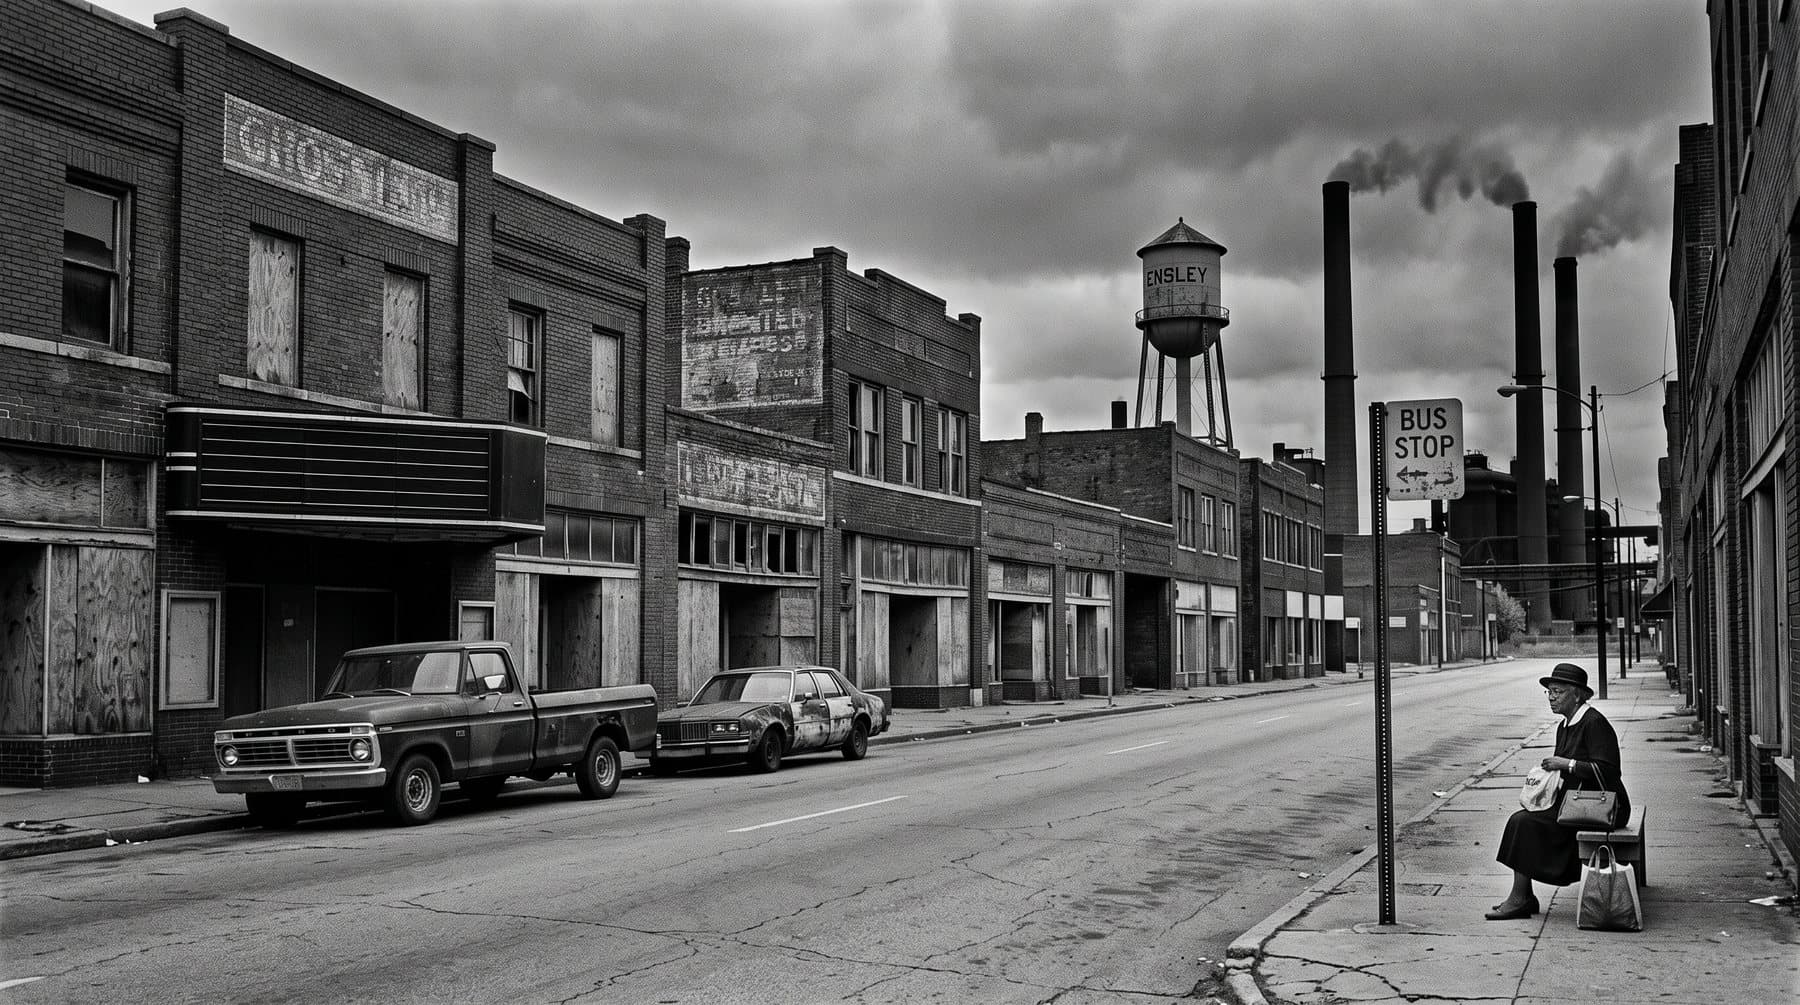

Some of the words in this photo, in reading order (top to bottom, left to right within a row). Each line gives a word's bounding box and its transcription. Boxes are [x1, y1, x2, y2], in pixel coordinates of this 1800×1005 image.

[1147, 267, 1207, 287] ENSLEY
[1400, 407, 1447, 431] BUS
[1395, 435, 1454, 459] STOP
